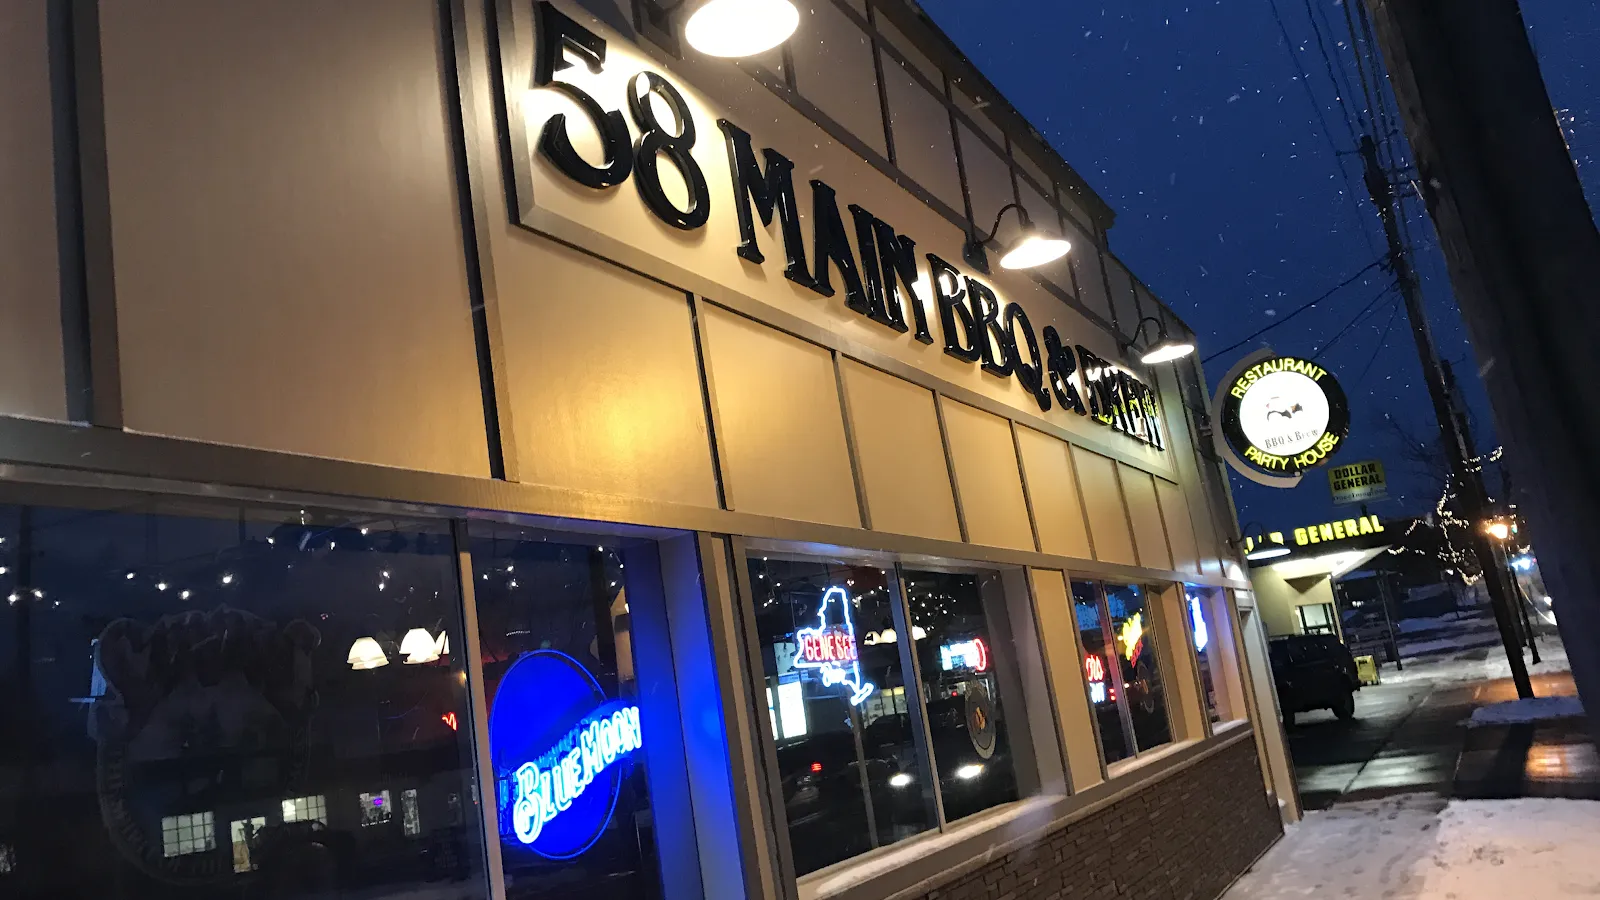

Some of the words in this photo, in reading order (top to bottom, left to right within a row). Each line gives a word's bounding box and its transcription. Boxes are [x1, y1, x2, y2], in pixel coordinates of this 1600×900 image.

[534, 2, 711, 231] 58
[717, 118, 934, 345] MAIN
[926, 252, 1051, 413] BBQ
[1043, 325, 1086, 416] &
[1231, 357, 1328, 399] RESTAURANT
[1244, 446, 1290, 470] PARTY
[1294, 431, 1340, 469] HOUSE
[1264, 436, 1285, 449] BBQ
[1333, 474, 1383, 491] GENERAL
[1334, 463, 1376, 479] DOLLAR
[1294, 514, 1385, 546] GENERAL
[804, 635, 857, 661] GENESEE
